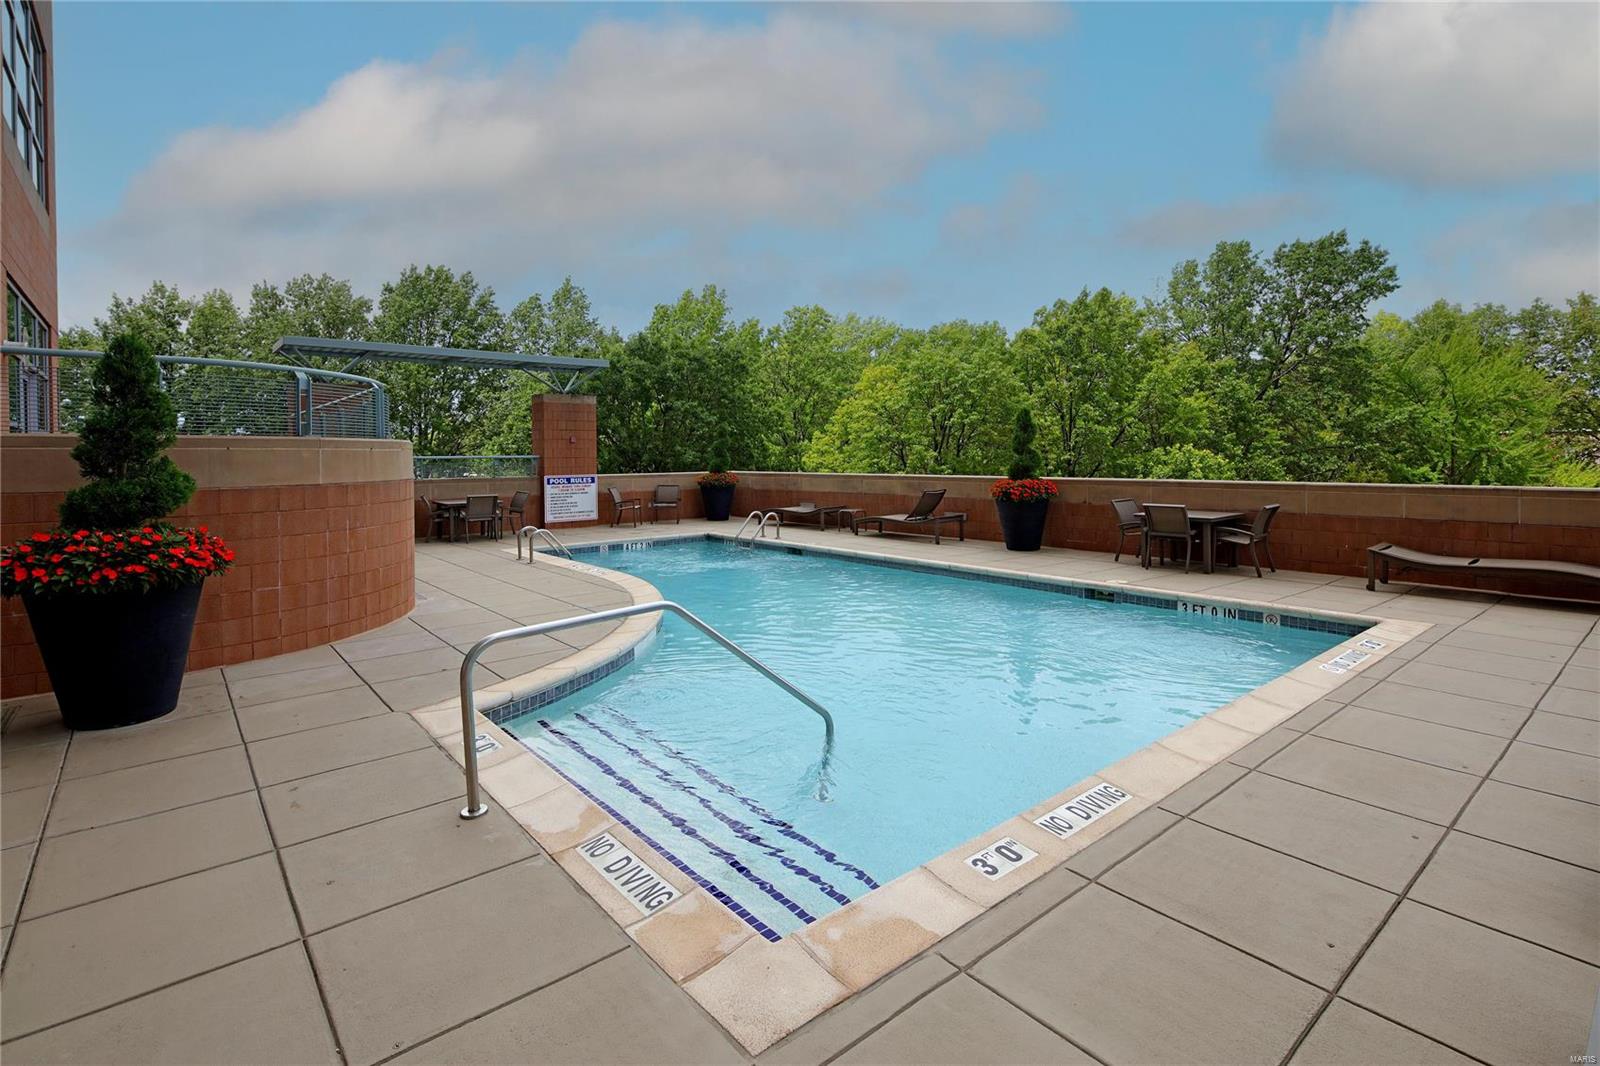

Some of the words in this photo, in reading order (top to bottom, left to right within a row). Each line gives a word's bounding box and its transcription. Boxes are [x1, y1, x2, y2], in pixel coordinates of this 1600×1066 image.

[1182, 603, 1188, 613] 3
[1192, 605, 1206, 616] FT
[1211, 606, 1218, 617] 0
[1224, 608, 1237, 619] IN
[1039, 815, 1074, 836] NO
[1065, 785, 1128, 821] DIVING
[580, 835, 615, 858] NO
[603, 855, 674, 911] DIVING
[971, 858, 999, 876] 3
[994, 844, 1023, 863] 0
